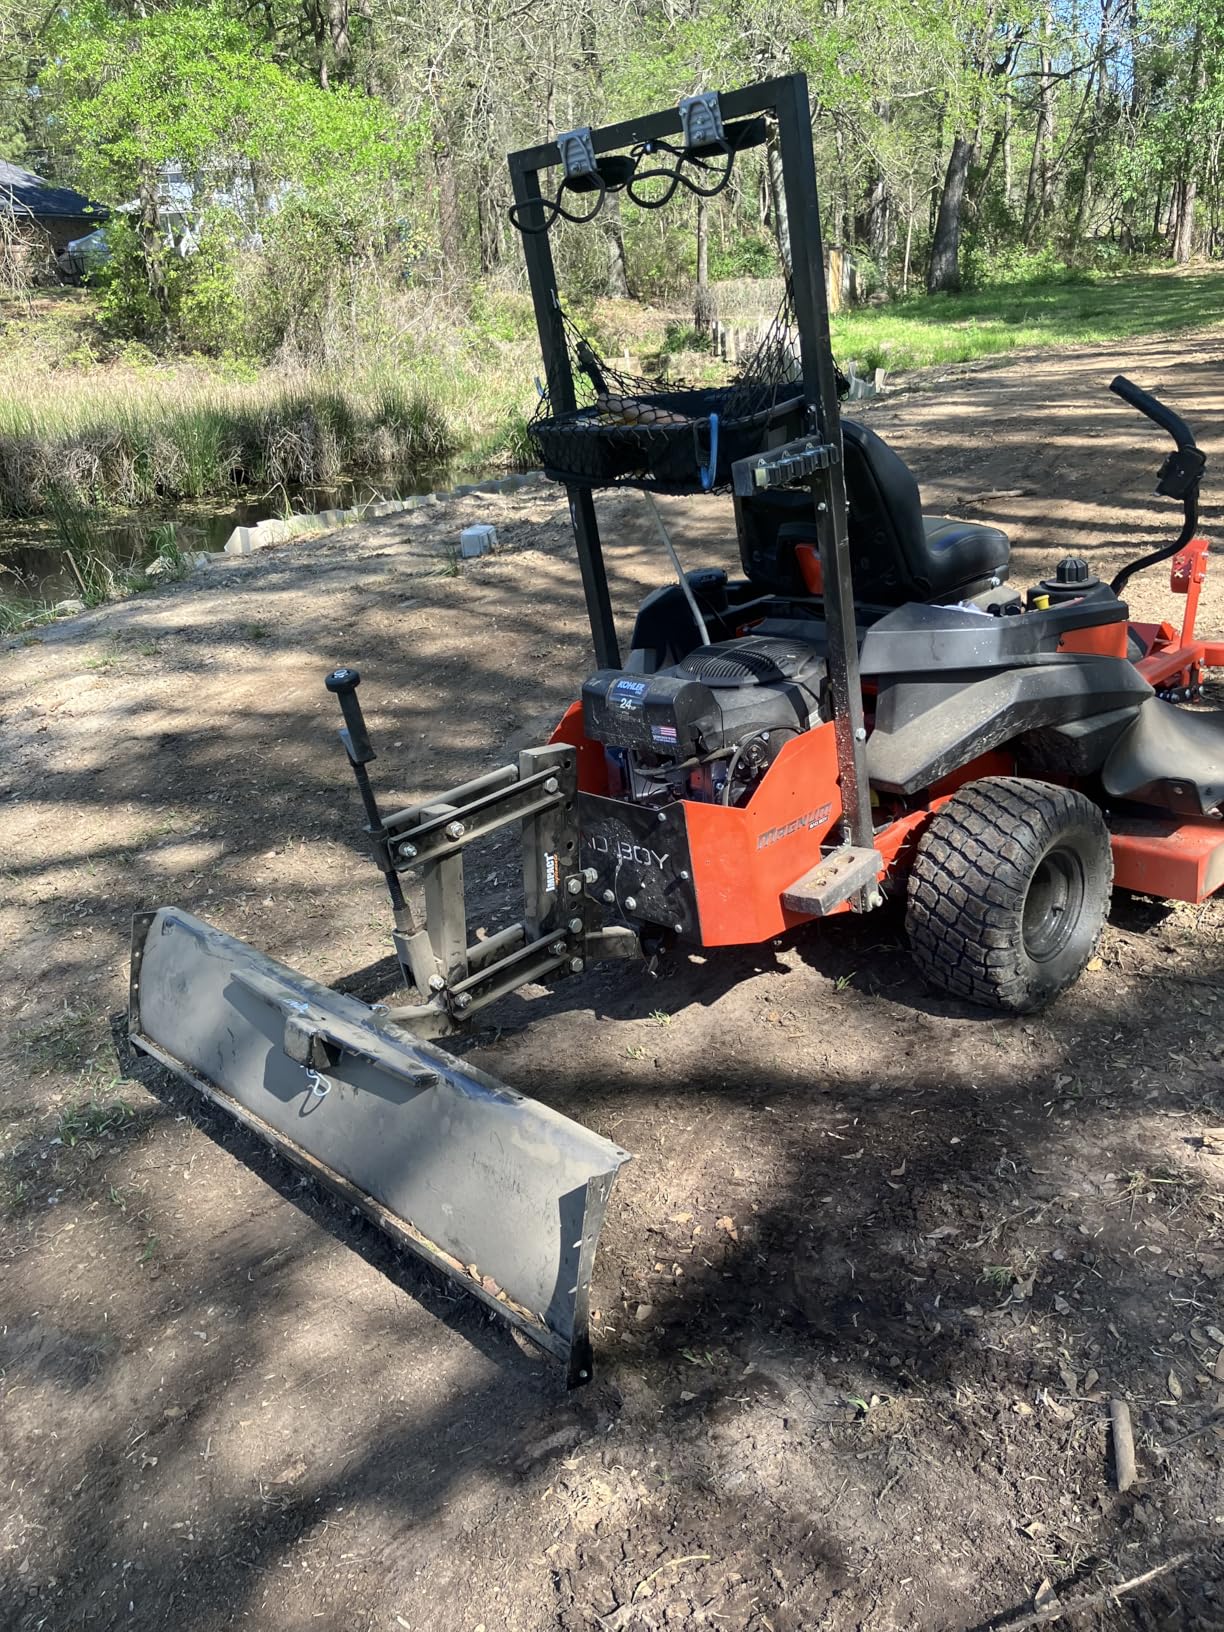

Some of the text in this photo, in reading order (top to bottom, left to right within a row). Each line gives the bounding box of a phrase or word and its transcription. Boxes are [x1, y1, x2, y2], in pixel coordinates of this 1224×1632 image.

[617, 680, 646, 692] KOHLER
[620, 698, 632, 710] 24
[617, 840, 669, 870] BOY
[545, 854, 555, 892] IMPACT
